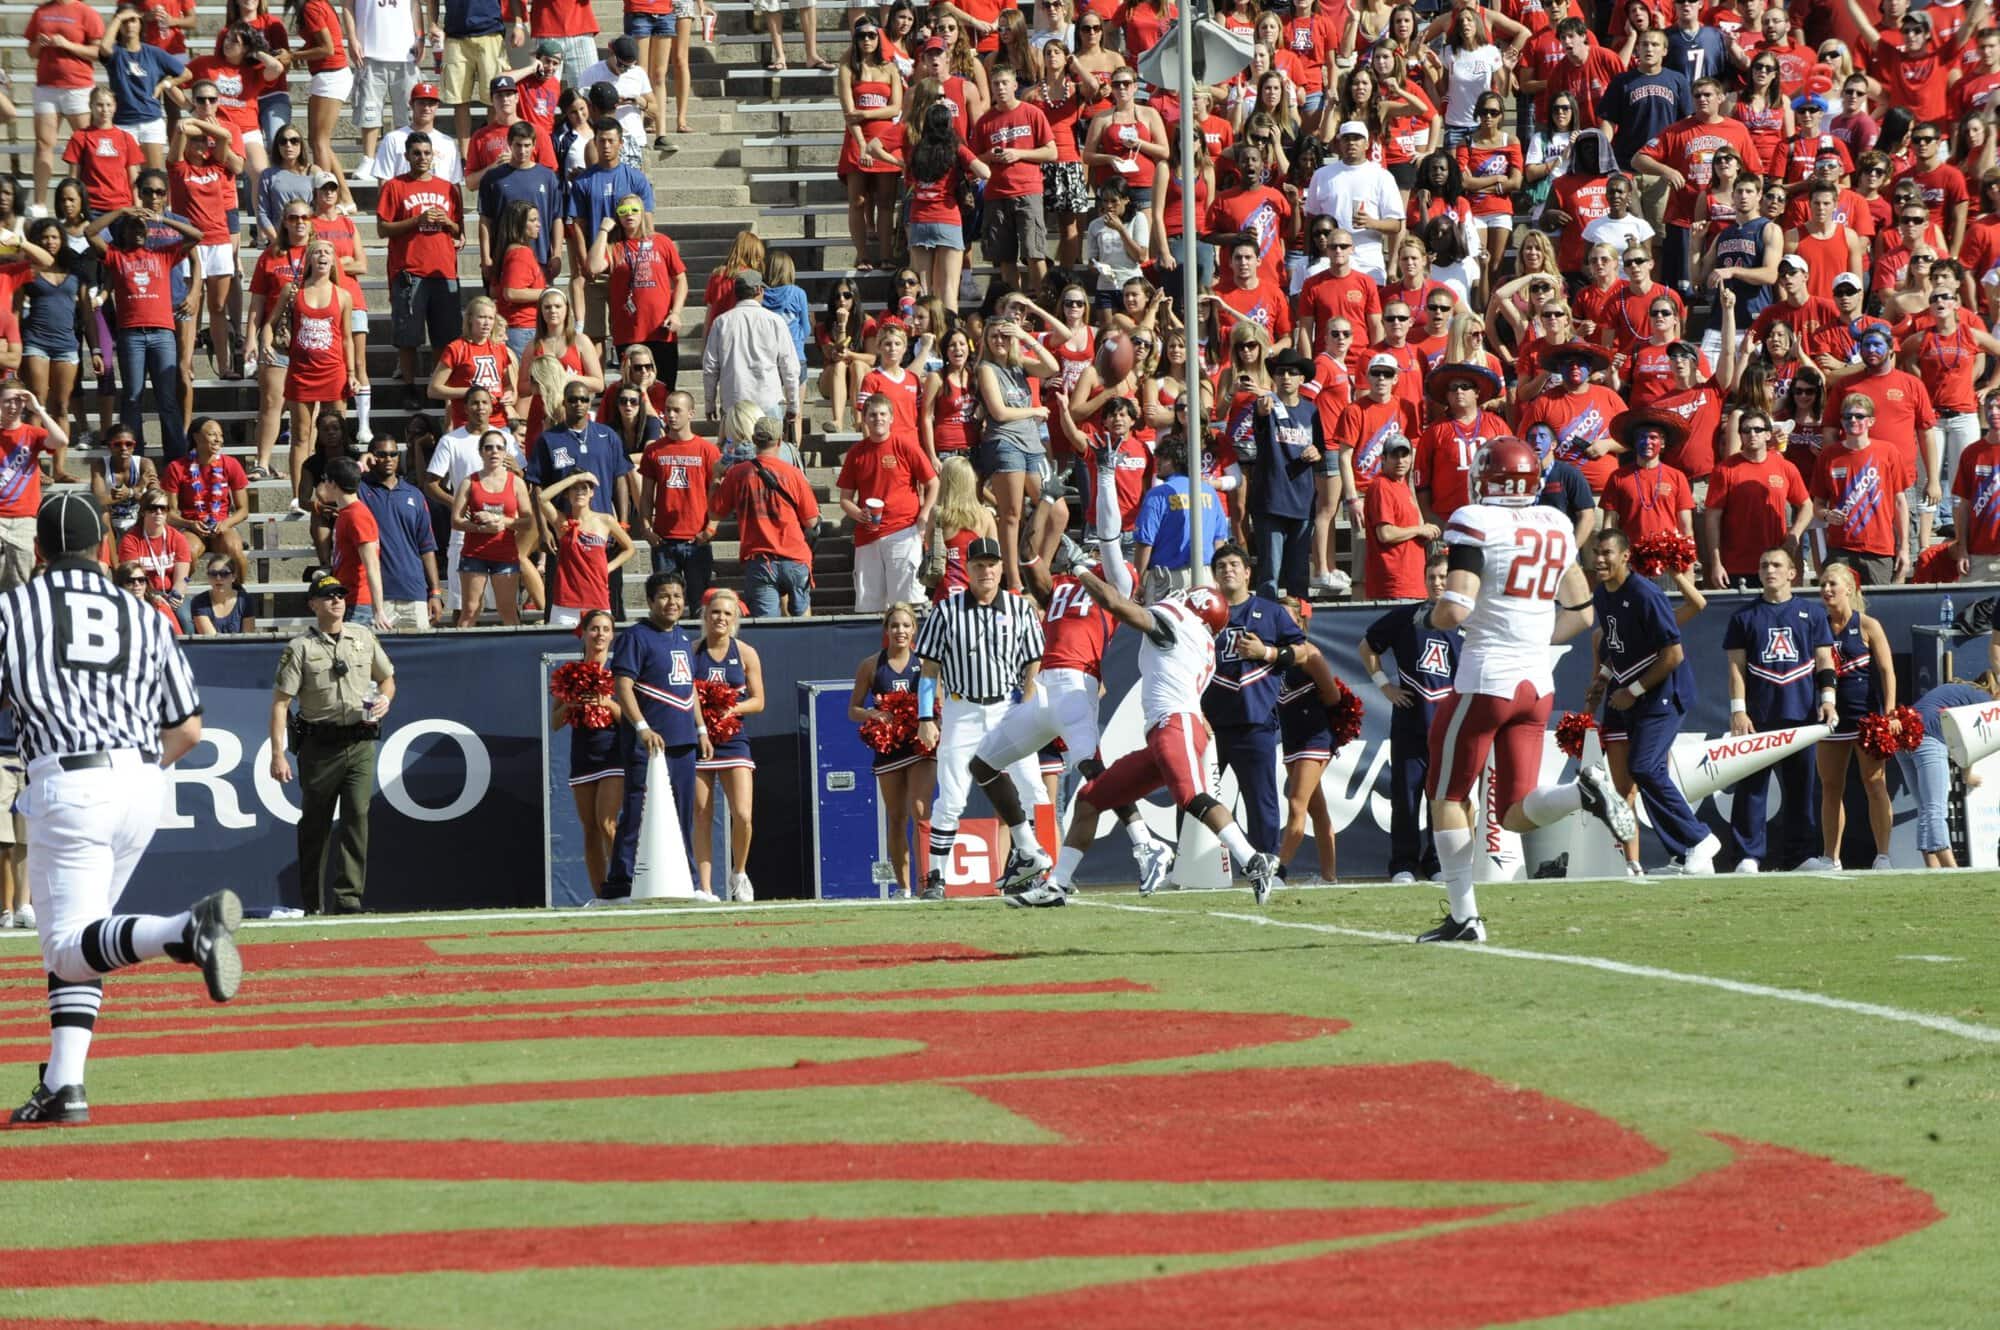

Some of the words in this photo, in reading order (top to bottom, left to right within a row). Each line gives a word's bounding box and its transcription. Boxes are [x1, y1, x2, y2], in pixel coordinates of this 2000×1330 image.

[1687, 49, 1705, 80] 7
[422, 84, 432, 94] T
[497, 78, 508, 87] A
[1631, 85, 1675, 105] ARIZONA
[404, 193, 451, 212] ARIZONA
[471, 355, 501, 388] A
[657, 456, 703, 467] WILDCATS
[663, 466, 685, 489] A
[1169, 493, 1213, 511] SECTY
[1504, 479, 1527, 495] 28
[1842, 466, 1879, 514] ONAZOO
[1504, 527, 1567, 600] 28
[1048, 584, 1093, 623] 84
[64, 592, 120, 665] B
[1763, 627, 1799, 663] A
[668, 650, 693, 685] A
[1416, 638, 1451, 677] A
[1708, 729, 1798, 762] ARIZONA
[1486, 764, 1503, 853] ARIZONA
[945, 832, 991, 887] G
